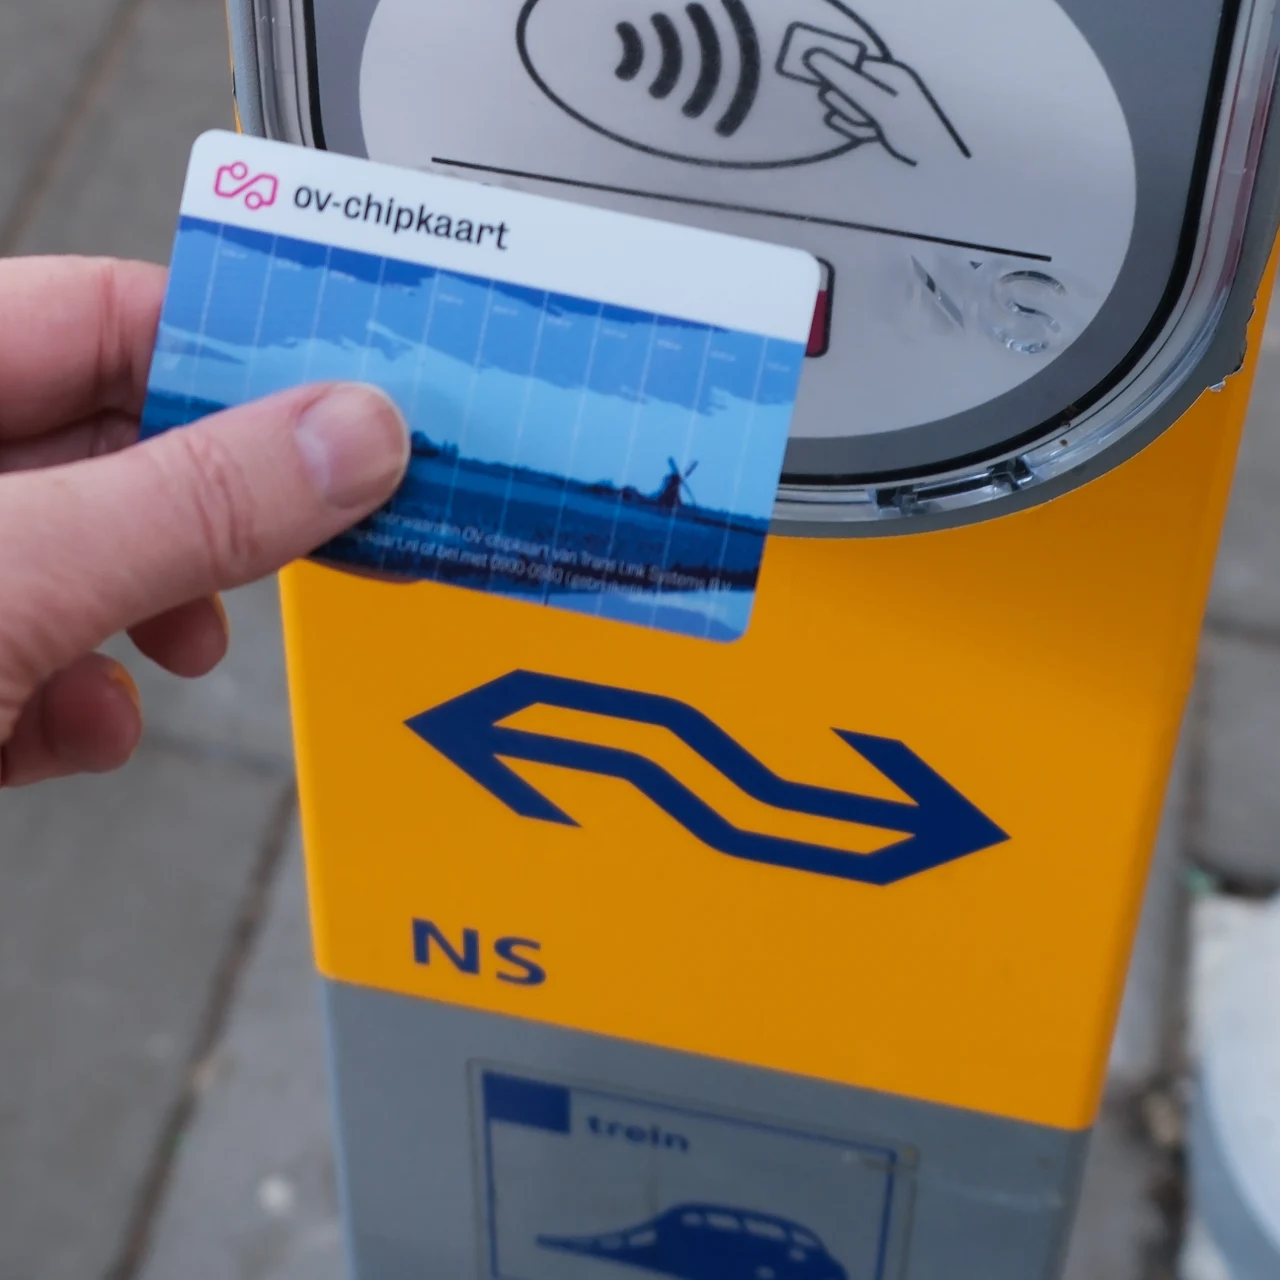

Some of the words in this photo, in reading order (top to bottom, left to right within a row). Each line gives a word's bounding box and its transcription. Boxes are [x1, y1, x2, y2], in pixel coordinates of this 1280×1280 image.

[293, 185, 509, 251] ov-chipkaart
[411, 917, 548, 987] NS
[587, 1114, 691, 1154] trein
